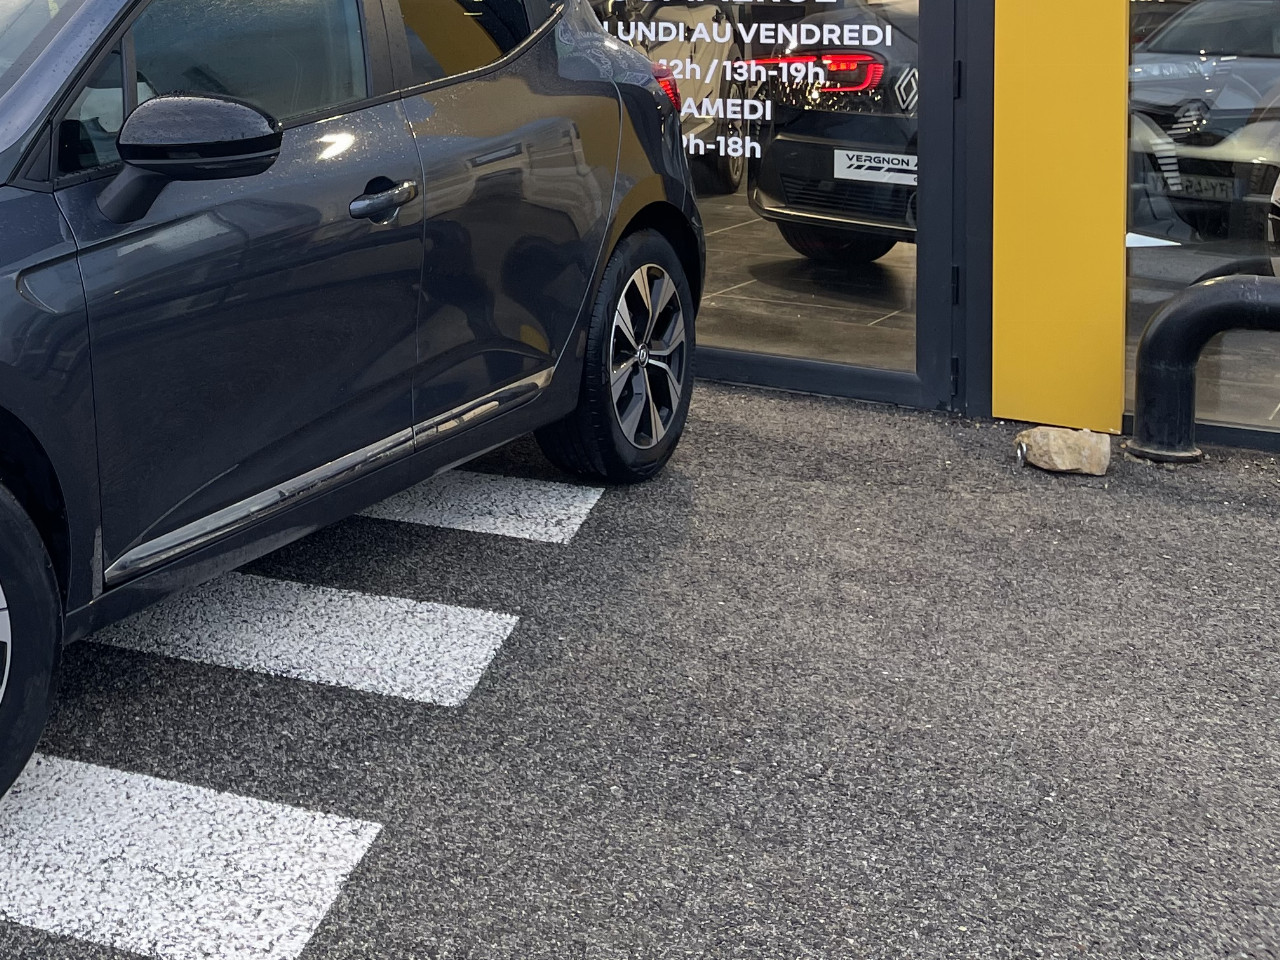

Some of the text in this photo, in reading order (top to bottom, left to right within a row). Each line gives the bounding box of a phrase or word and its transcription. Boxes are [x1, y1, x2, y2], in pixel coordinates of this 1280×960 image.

[691, 22, 732, 43] AU
[737, 23, 892, 46] VENDREDI
[680, 97, 772, 121] AMEDI
[846, 153, 910, 167] VERGNON
